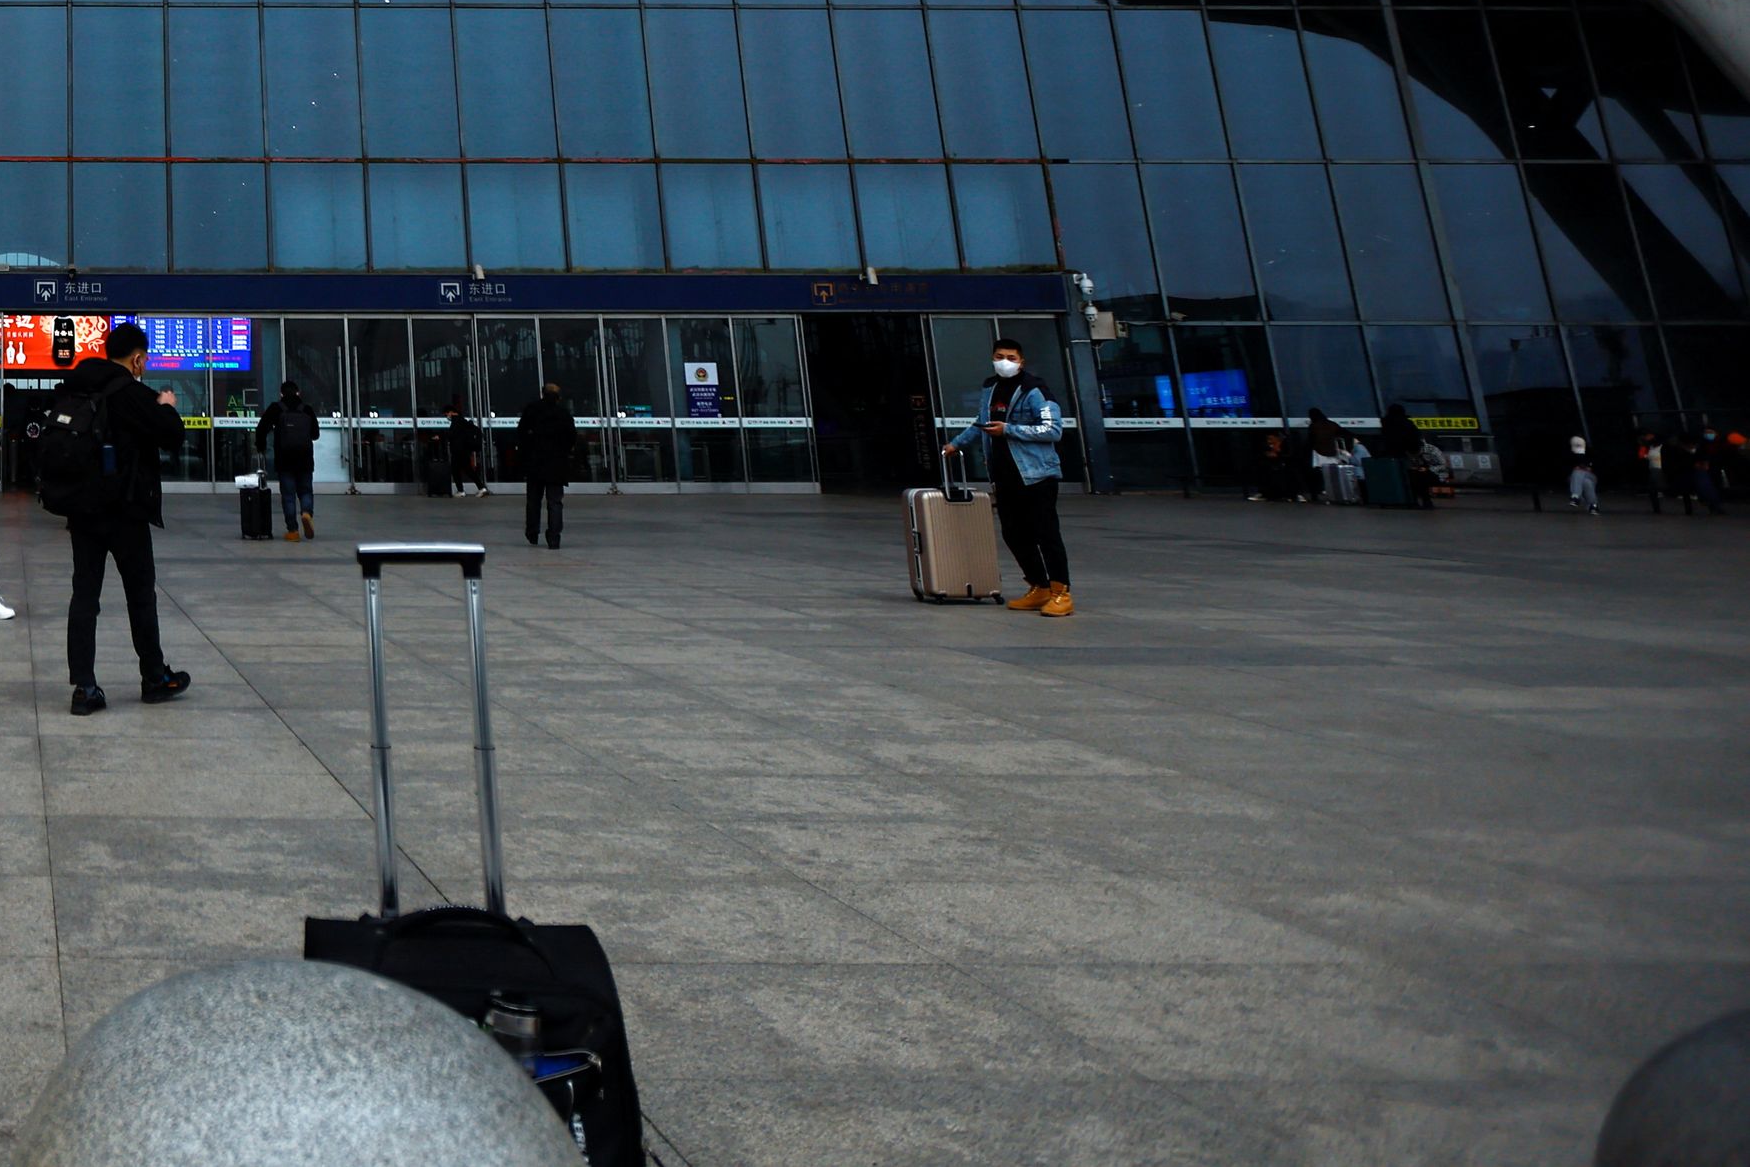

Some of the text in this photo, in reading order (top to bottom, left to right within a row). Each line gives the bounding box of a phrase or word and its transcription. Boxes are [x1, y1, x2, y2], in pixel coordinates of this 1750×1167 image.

[65, 282, 102, 294] 东进口
[468, 283, 506, 295] 东进口
